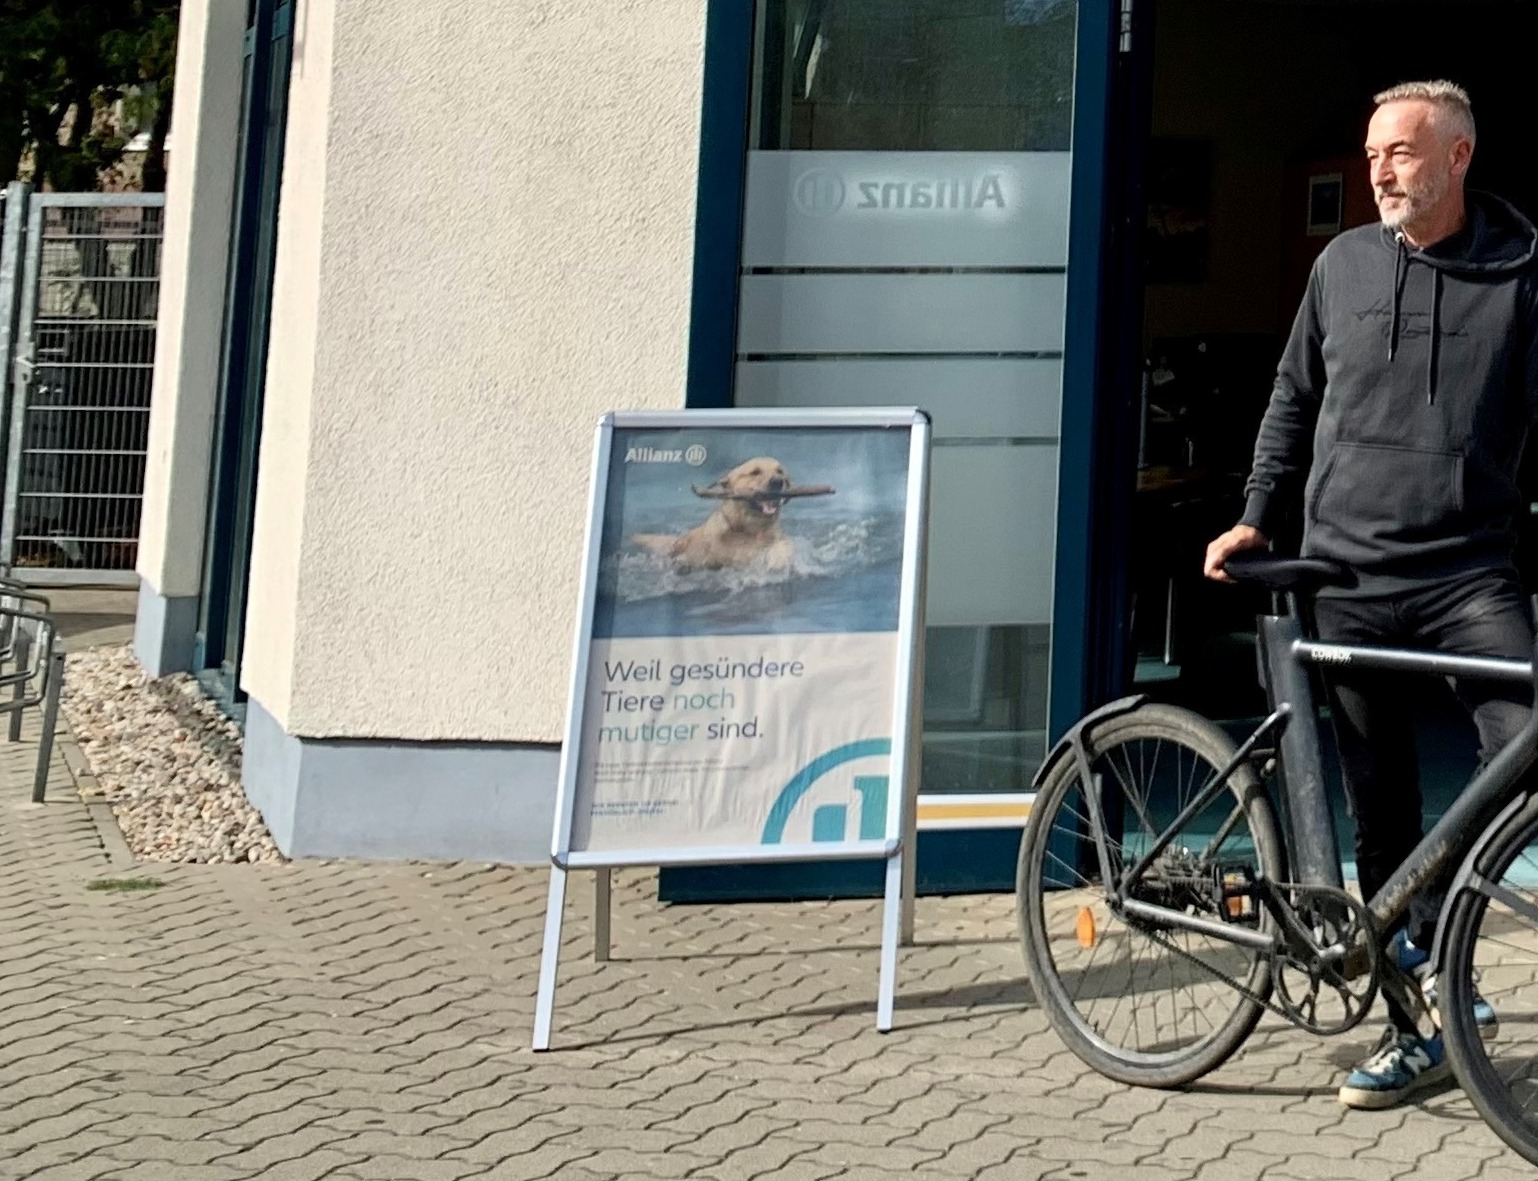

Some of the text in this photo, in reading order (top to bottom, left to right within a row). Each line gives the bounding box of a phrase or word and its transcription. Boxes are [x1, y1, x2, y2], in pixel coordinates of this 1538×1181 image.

[624, 446, 682, 463] Allianz
[604, 656, 804, 686] Weil gesündere
[601, 687, 735, 713] Tiere noch
[599, 715, 764, 746] mutiger sind.
